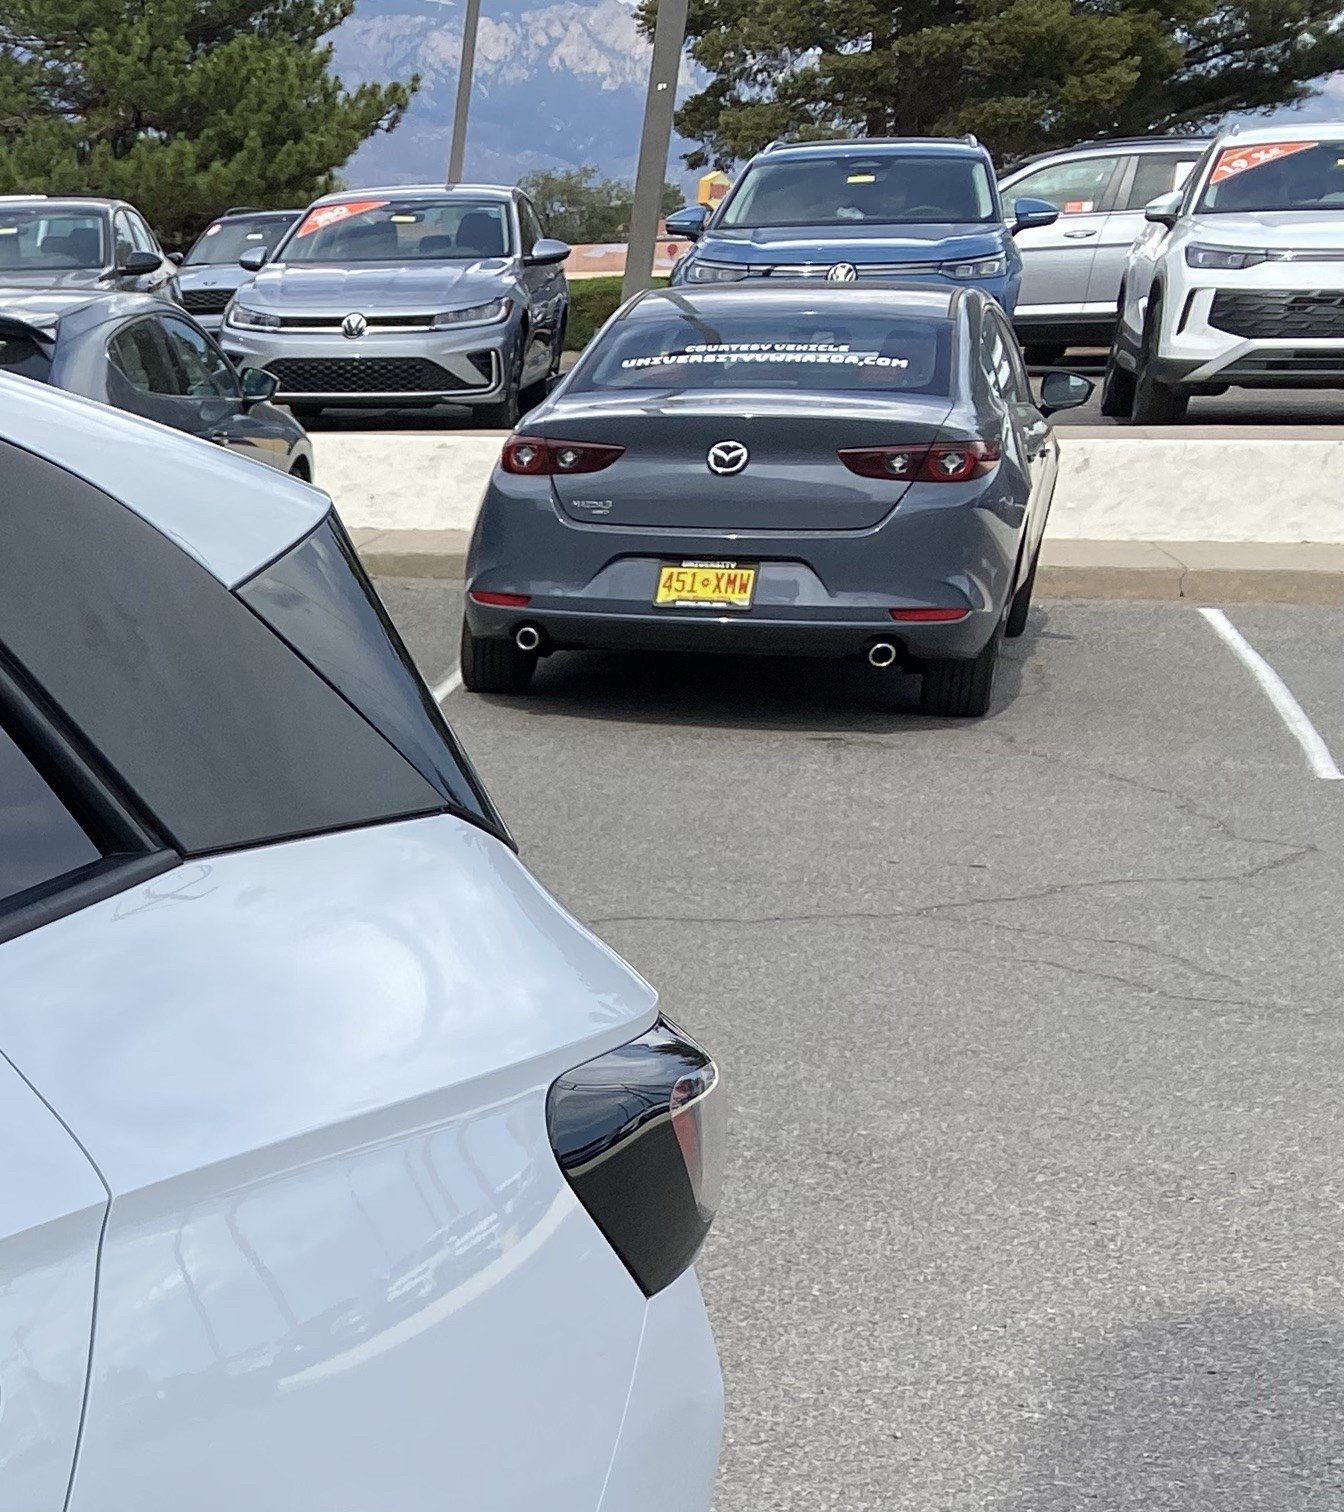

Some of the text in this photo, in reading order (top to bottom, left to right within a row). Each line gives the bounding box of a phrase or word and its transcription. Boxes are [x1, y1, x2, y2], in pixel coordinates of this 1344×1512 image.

[684, 343, 851, 353] COURTESY VEHICLE
[662, 571, 751, 594] 451 XMW
